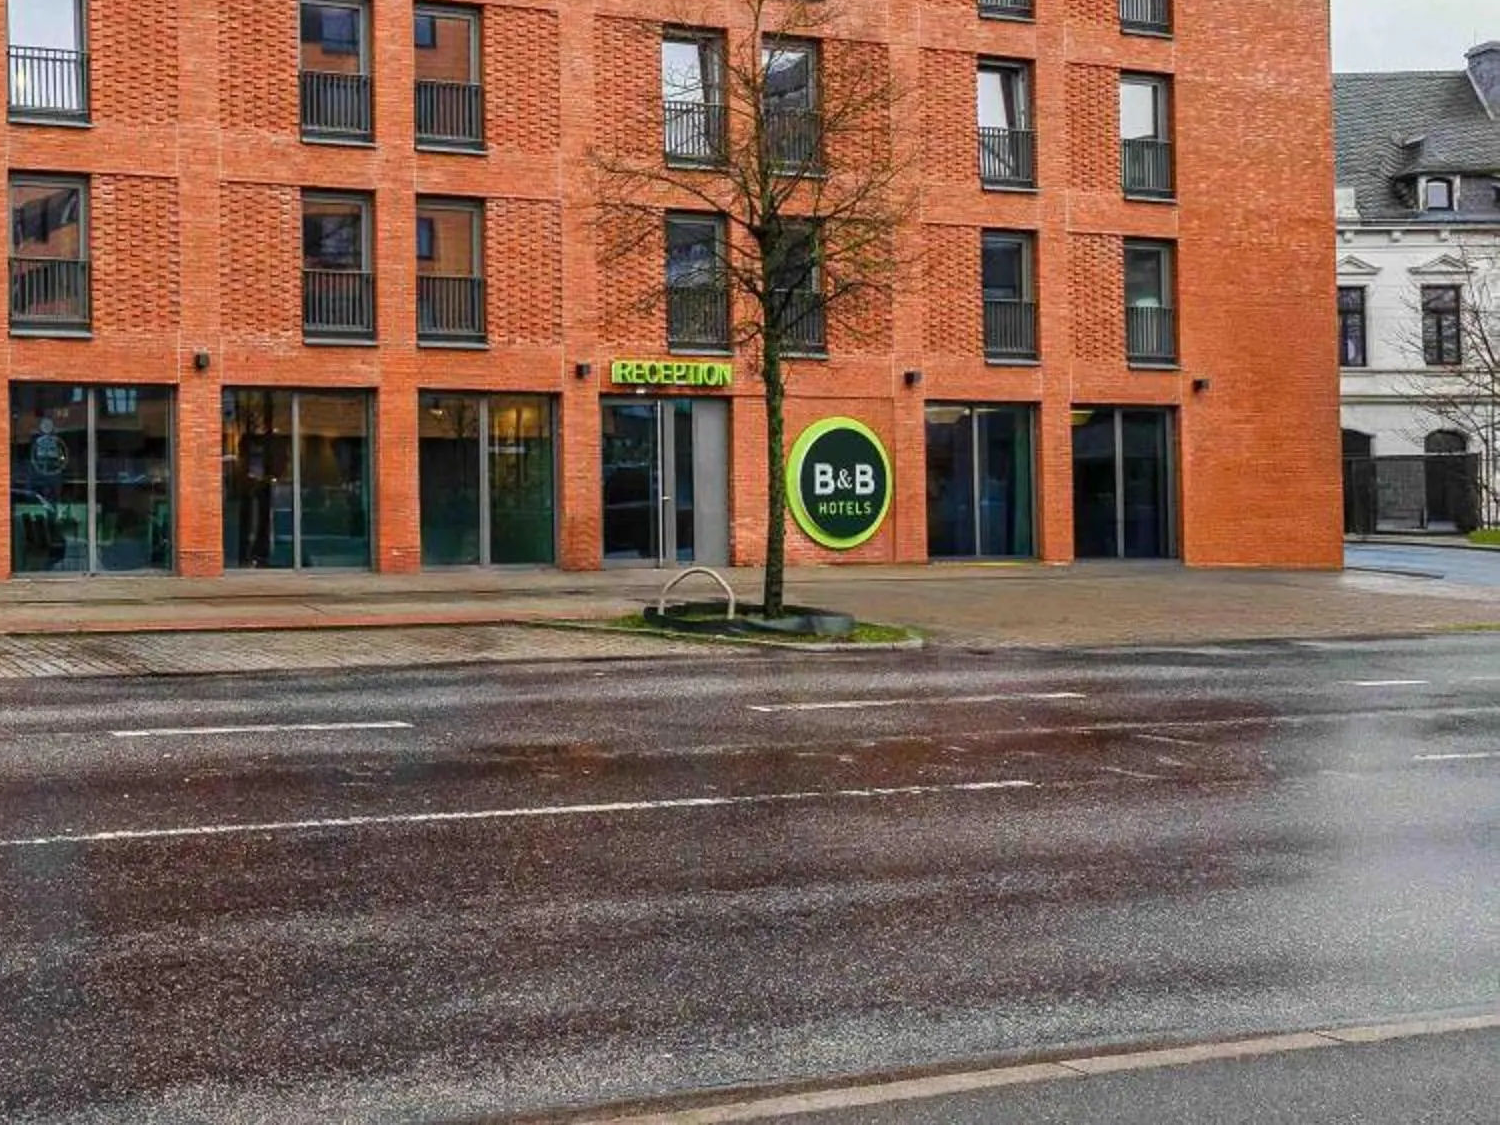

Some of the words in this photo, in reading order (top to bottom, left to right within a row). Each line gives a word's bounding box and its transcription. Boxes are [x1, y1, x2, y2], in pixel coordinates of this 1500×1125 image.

[612, 360, 733, 386] RECEPTION
[814, 462, 875, 495] B&B
[819, 501, 872, 515] HOTELS
